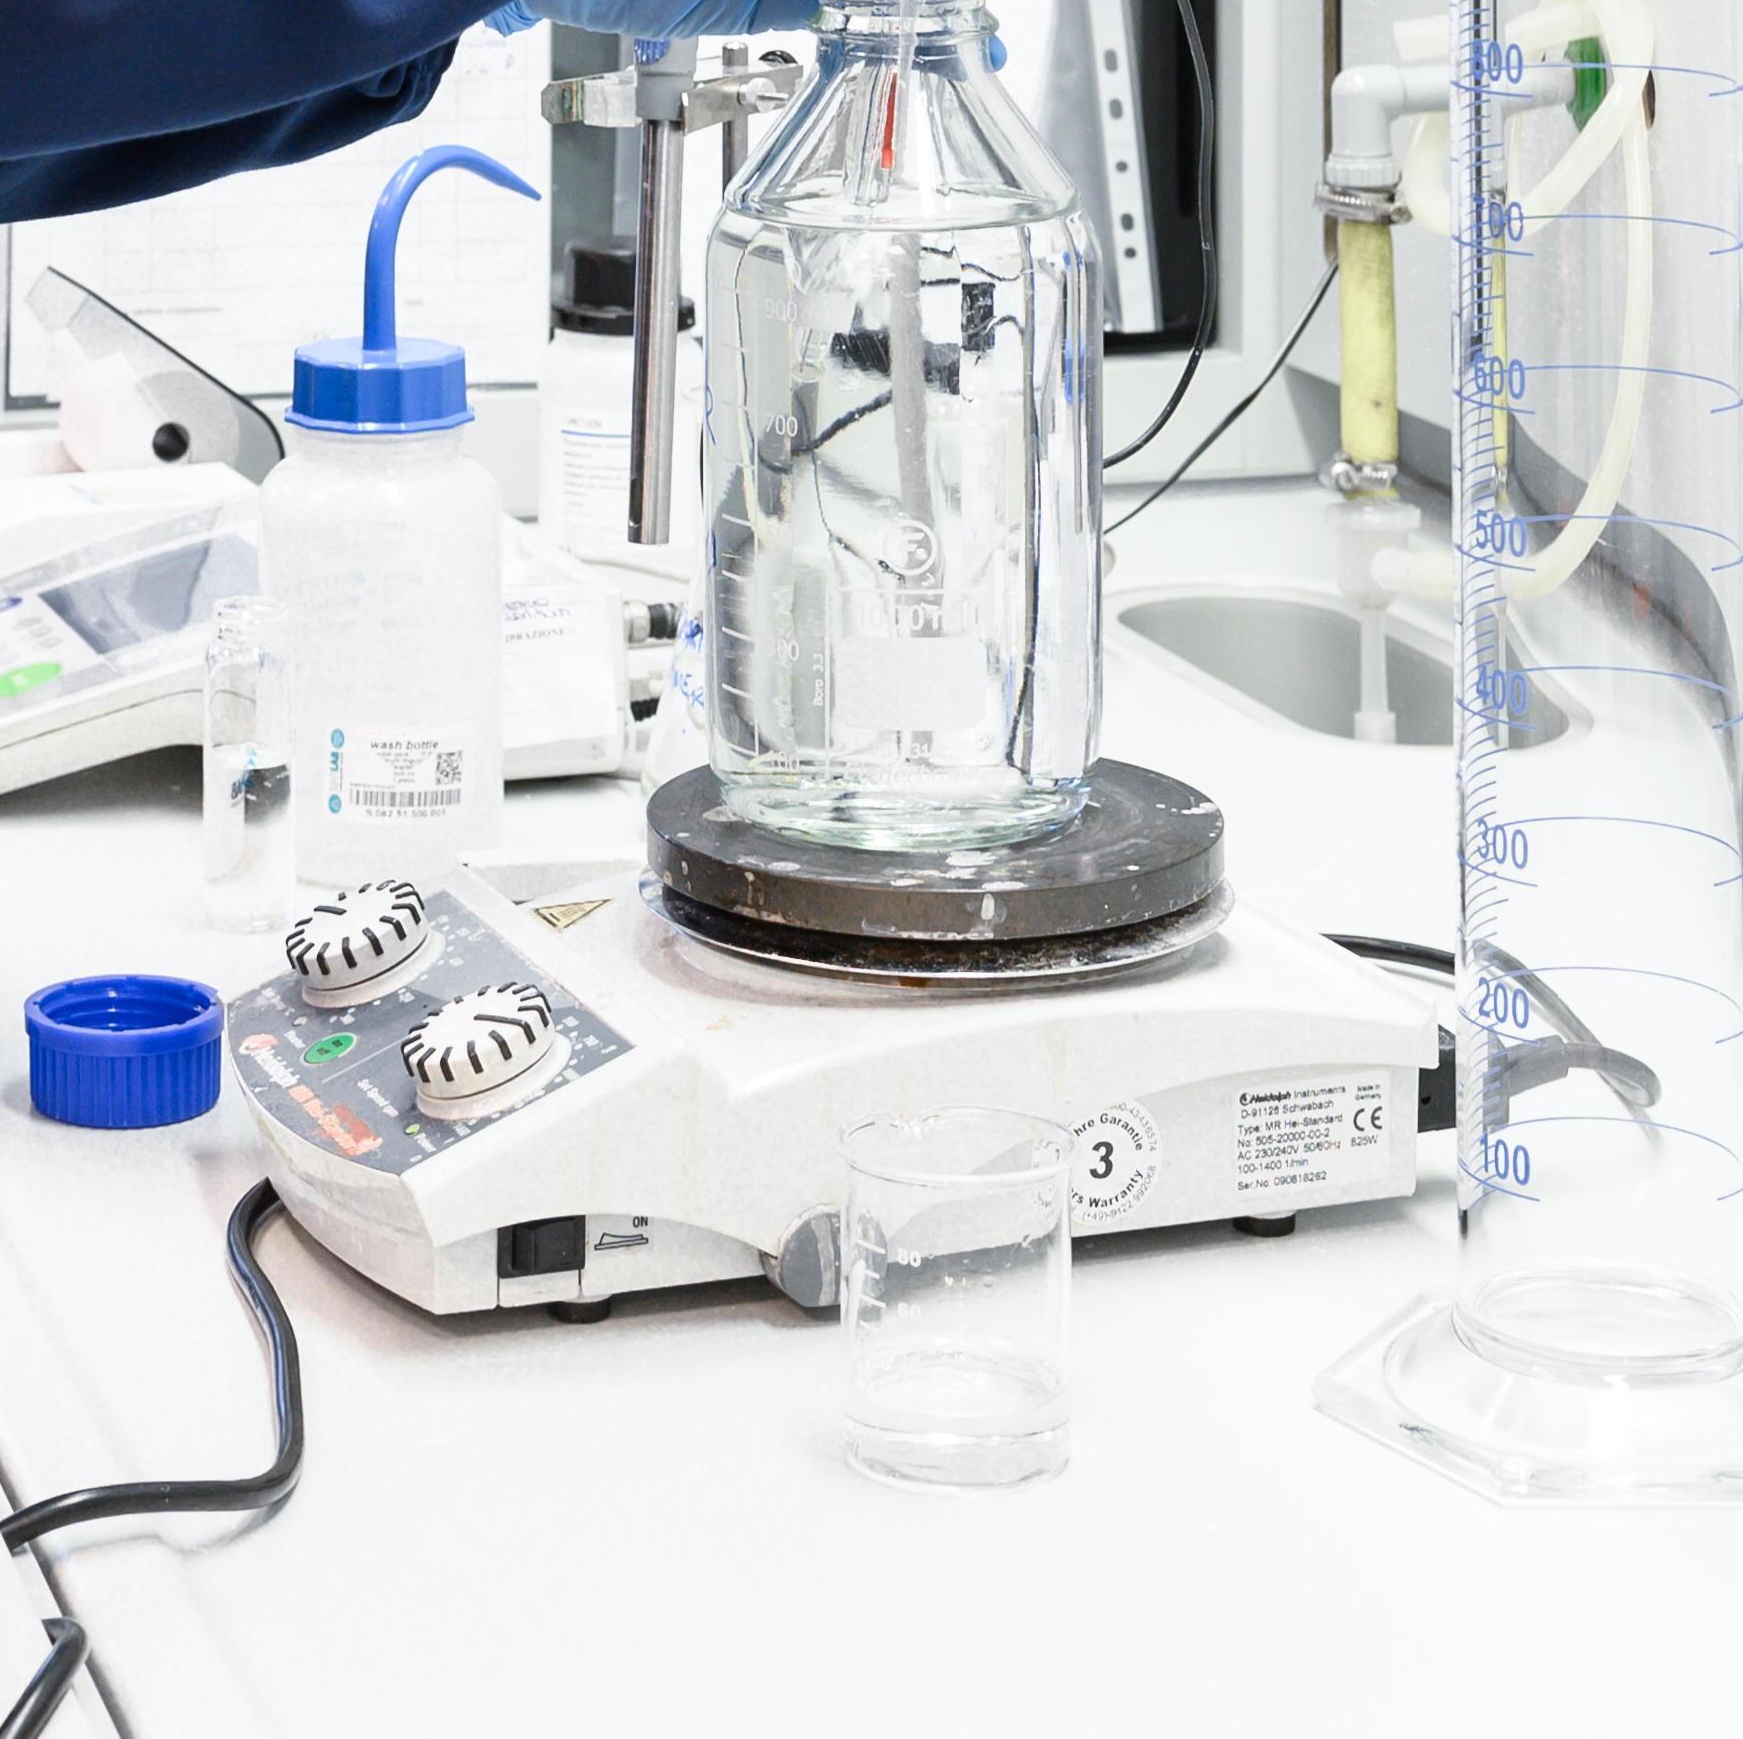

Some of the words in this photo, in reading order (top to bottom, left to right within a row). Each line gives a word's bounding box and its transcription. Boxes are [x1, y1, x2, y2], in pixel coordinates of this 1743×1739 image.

[1471, 40, 1523, 84] 800
[764, 298, 798, 323] 900
[1475, 353, 1526, 399] 600
[765, 415, 799, 438] 700
[1476, 508, 1527, 558] 500
[813, 652, 824, 673] 3.3
[813, 679, 824, 707] Boro
[1476, 662, 1529, 715] 400
[370, 741, 403, 750] wash
[405, 740, 439, 750] bottle
[1477, 818, 1529, 869] 300
[1478, 977, 1530, 1029] 200
[1293, 1085, 1346, 1099] Instruments
[1282, 1100, 1334, 1114] Schwabach
[1100, 1113, 1143, 1151] Garantie
[1265, 1120, 1281, 1131] MR
[1284, 1113, 1343, 1129] Hei-Standard
[1089, 1141, 1114, 1179] 3
[1238, 1150, 1252, 1160] AC
[1255, 1145, 1299, 1159] 230/240V
[1479, 1133, 1531, 1186] 100
[1238, 1160, 1282, 1174] 100-1400
[1089, 1169, 1144, 1208] Warranty
[632, 1215, 649, 1228] ON
[897, 1247, 921, 1268] 80
